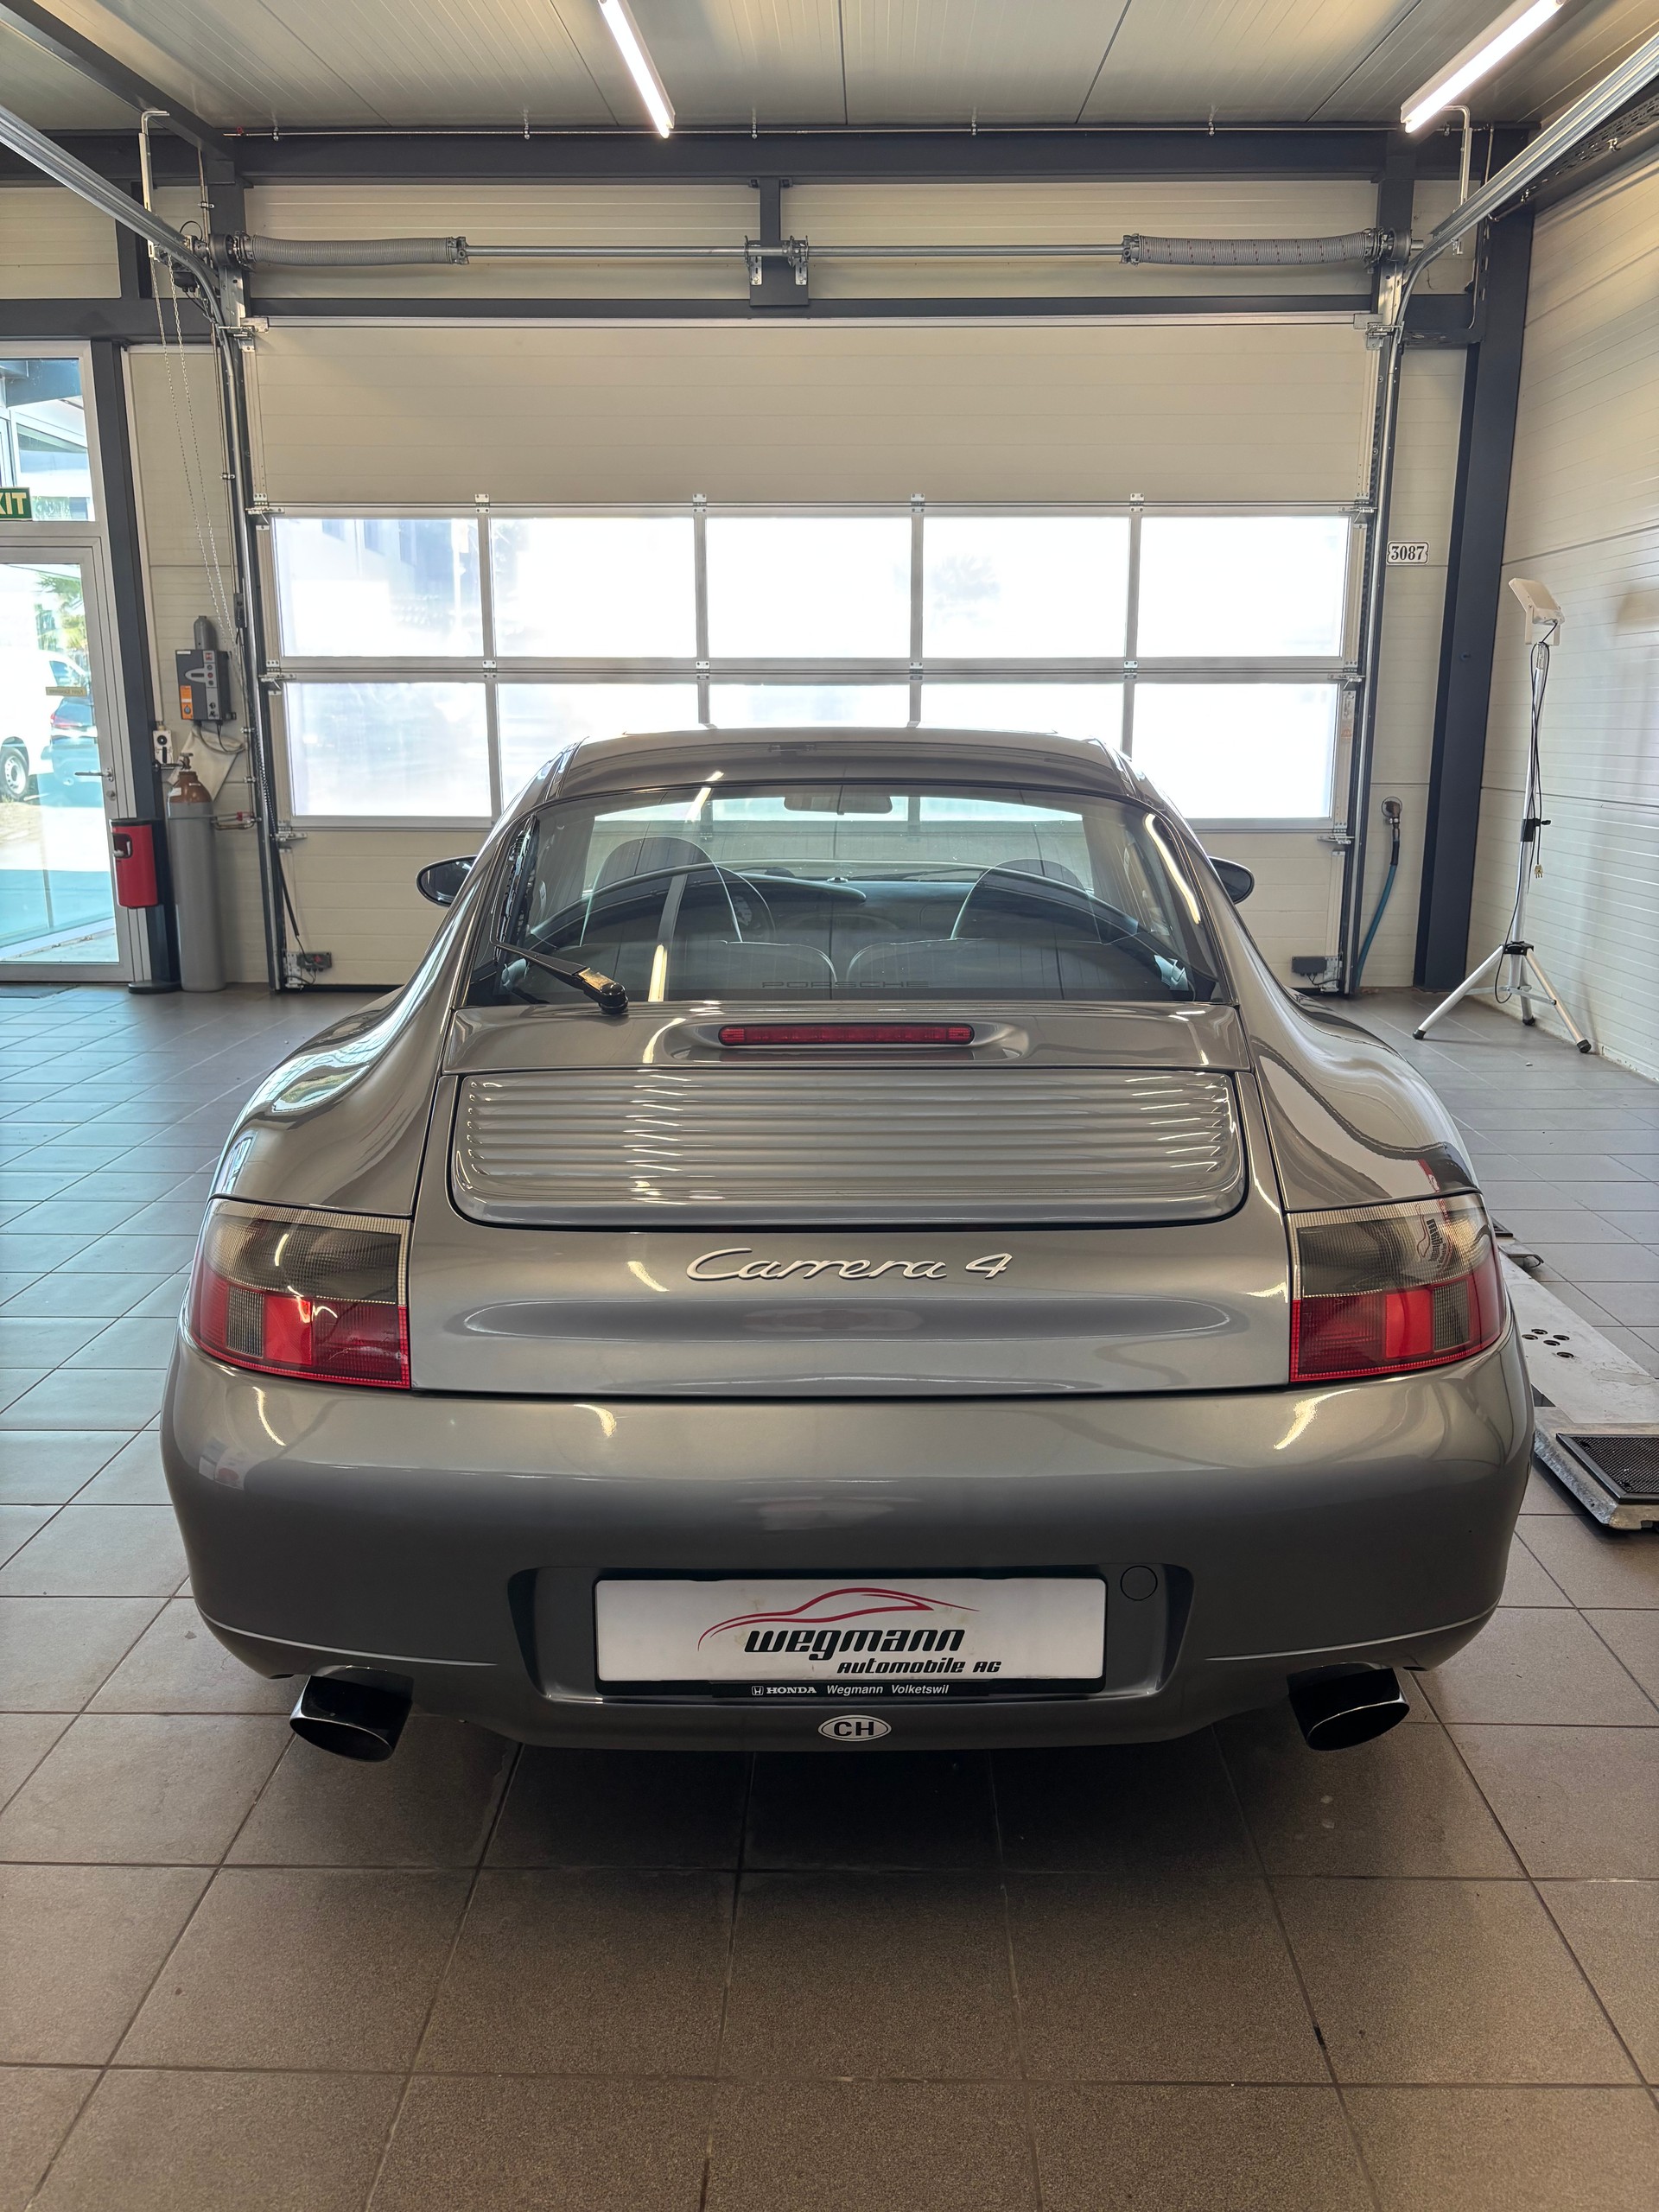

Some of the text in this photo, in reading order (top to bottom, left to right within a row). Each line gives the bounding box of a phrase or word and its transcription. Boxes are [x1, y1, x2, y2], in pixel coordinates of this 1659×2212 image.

[1391, 545, 1425, 561] 3087
[687, 1248, 1013, 1281] Carrera 4
[744, 1630, 965, 1661] wegmann
[972, 1661, 1002, 1673] AG
[826, 1685, 884, 1696] Wegmann
[891, 1684, 950, 1694] Volketswil
[834, 1721, 874, 1737] CH
